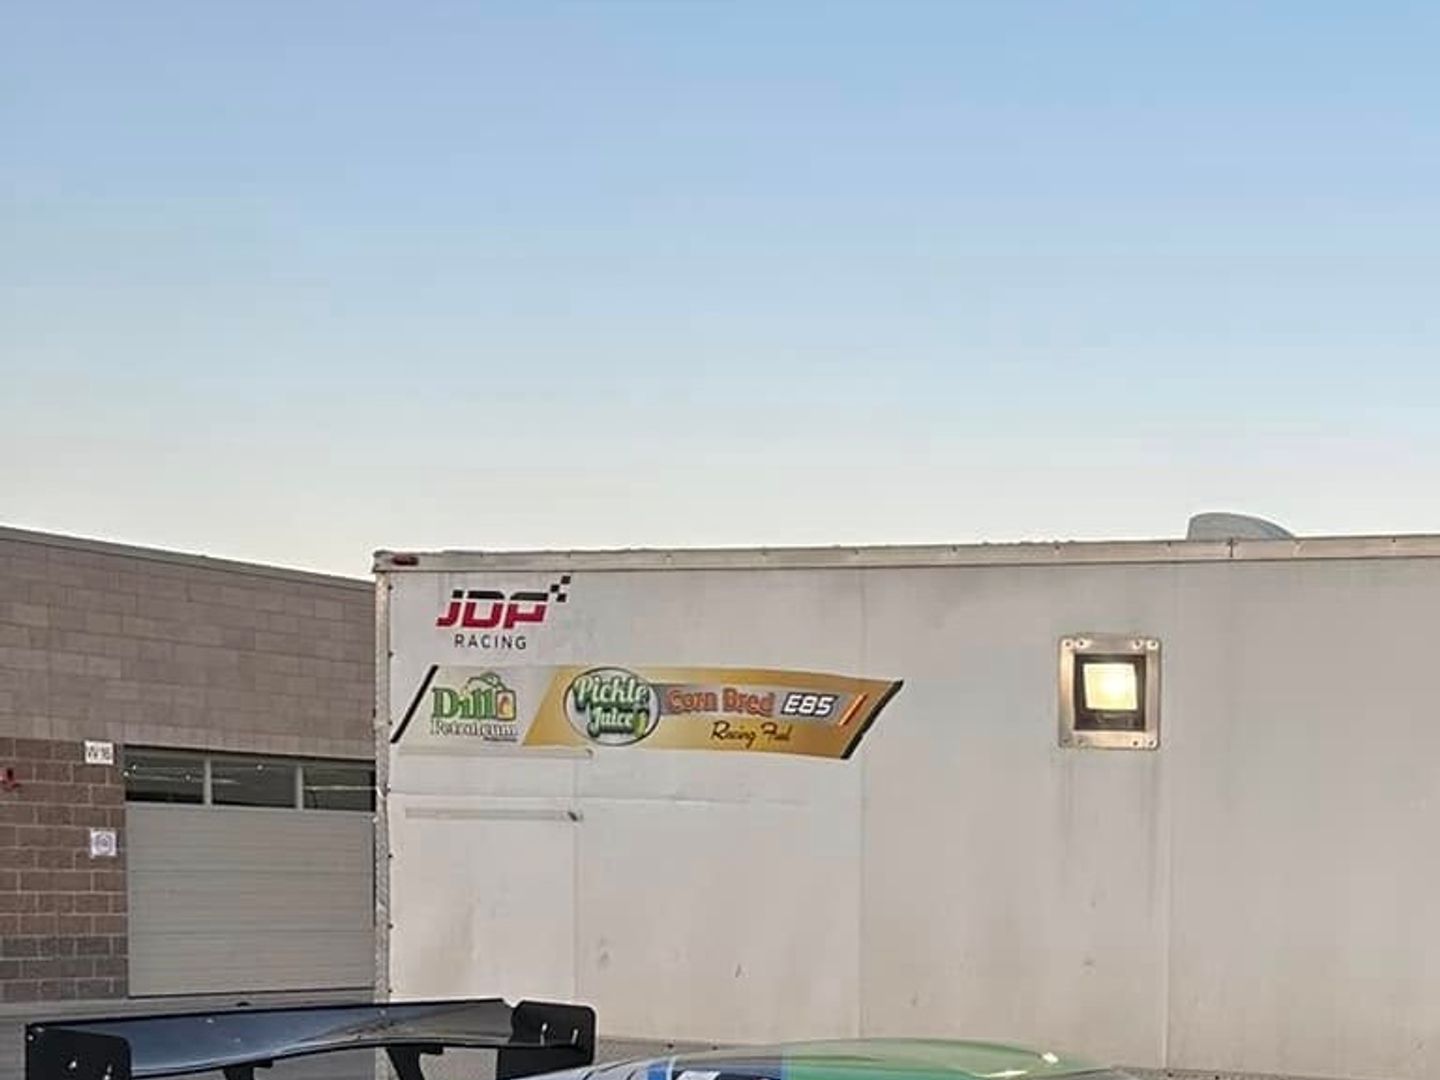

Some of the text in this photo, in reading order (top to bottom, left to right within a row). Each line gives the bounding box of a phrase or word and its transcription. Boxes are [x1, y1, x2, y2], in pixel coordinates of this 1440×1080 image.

[436, 590, 548, 629] JDP
[454, 633, 527, 650] RACING
[573, 676, 649, 712] Pickle
[667, 690, 717, 714] Corn
[781, 691, 837, 718] E85
[587, 706, 636, 738] Juice
[711, 720, 755, 748] Racing
